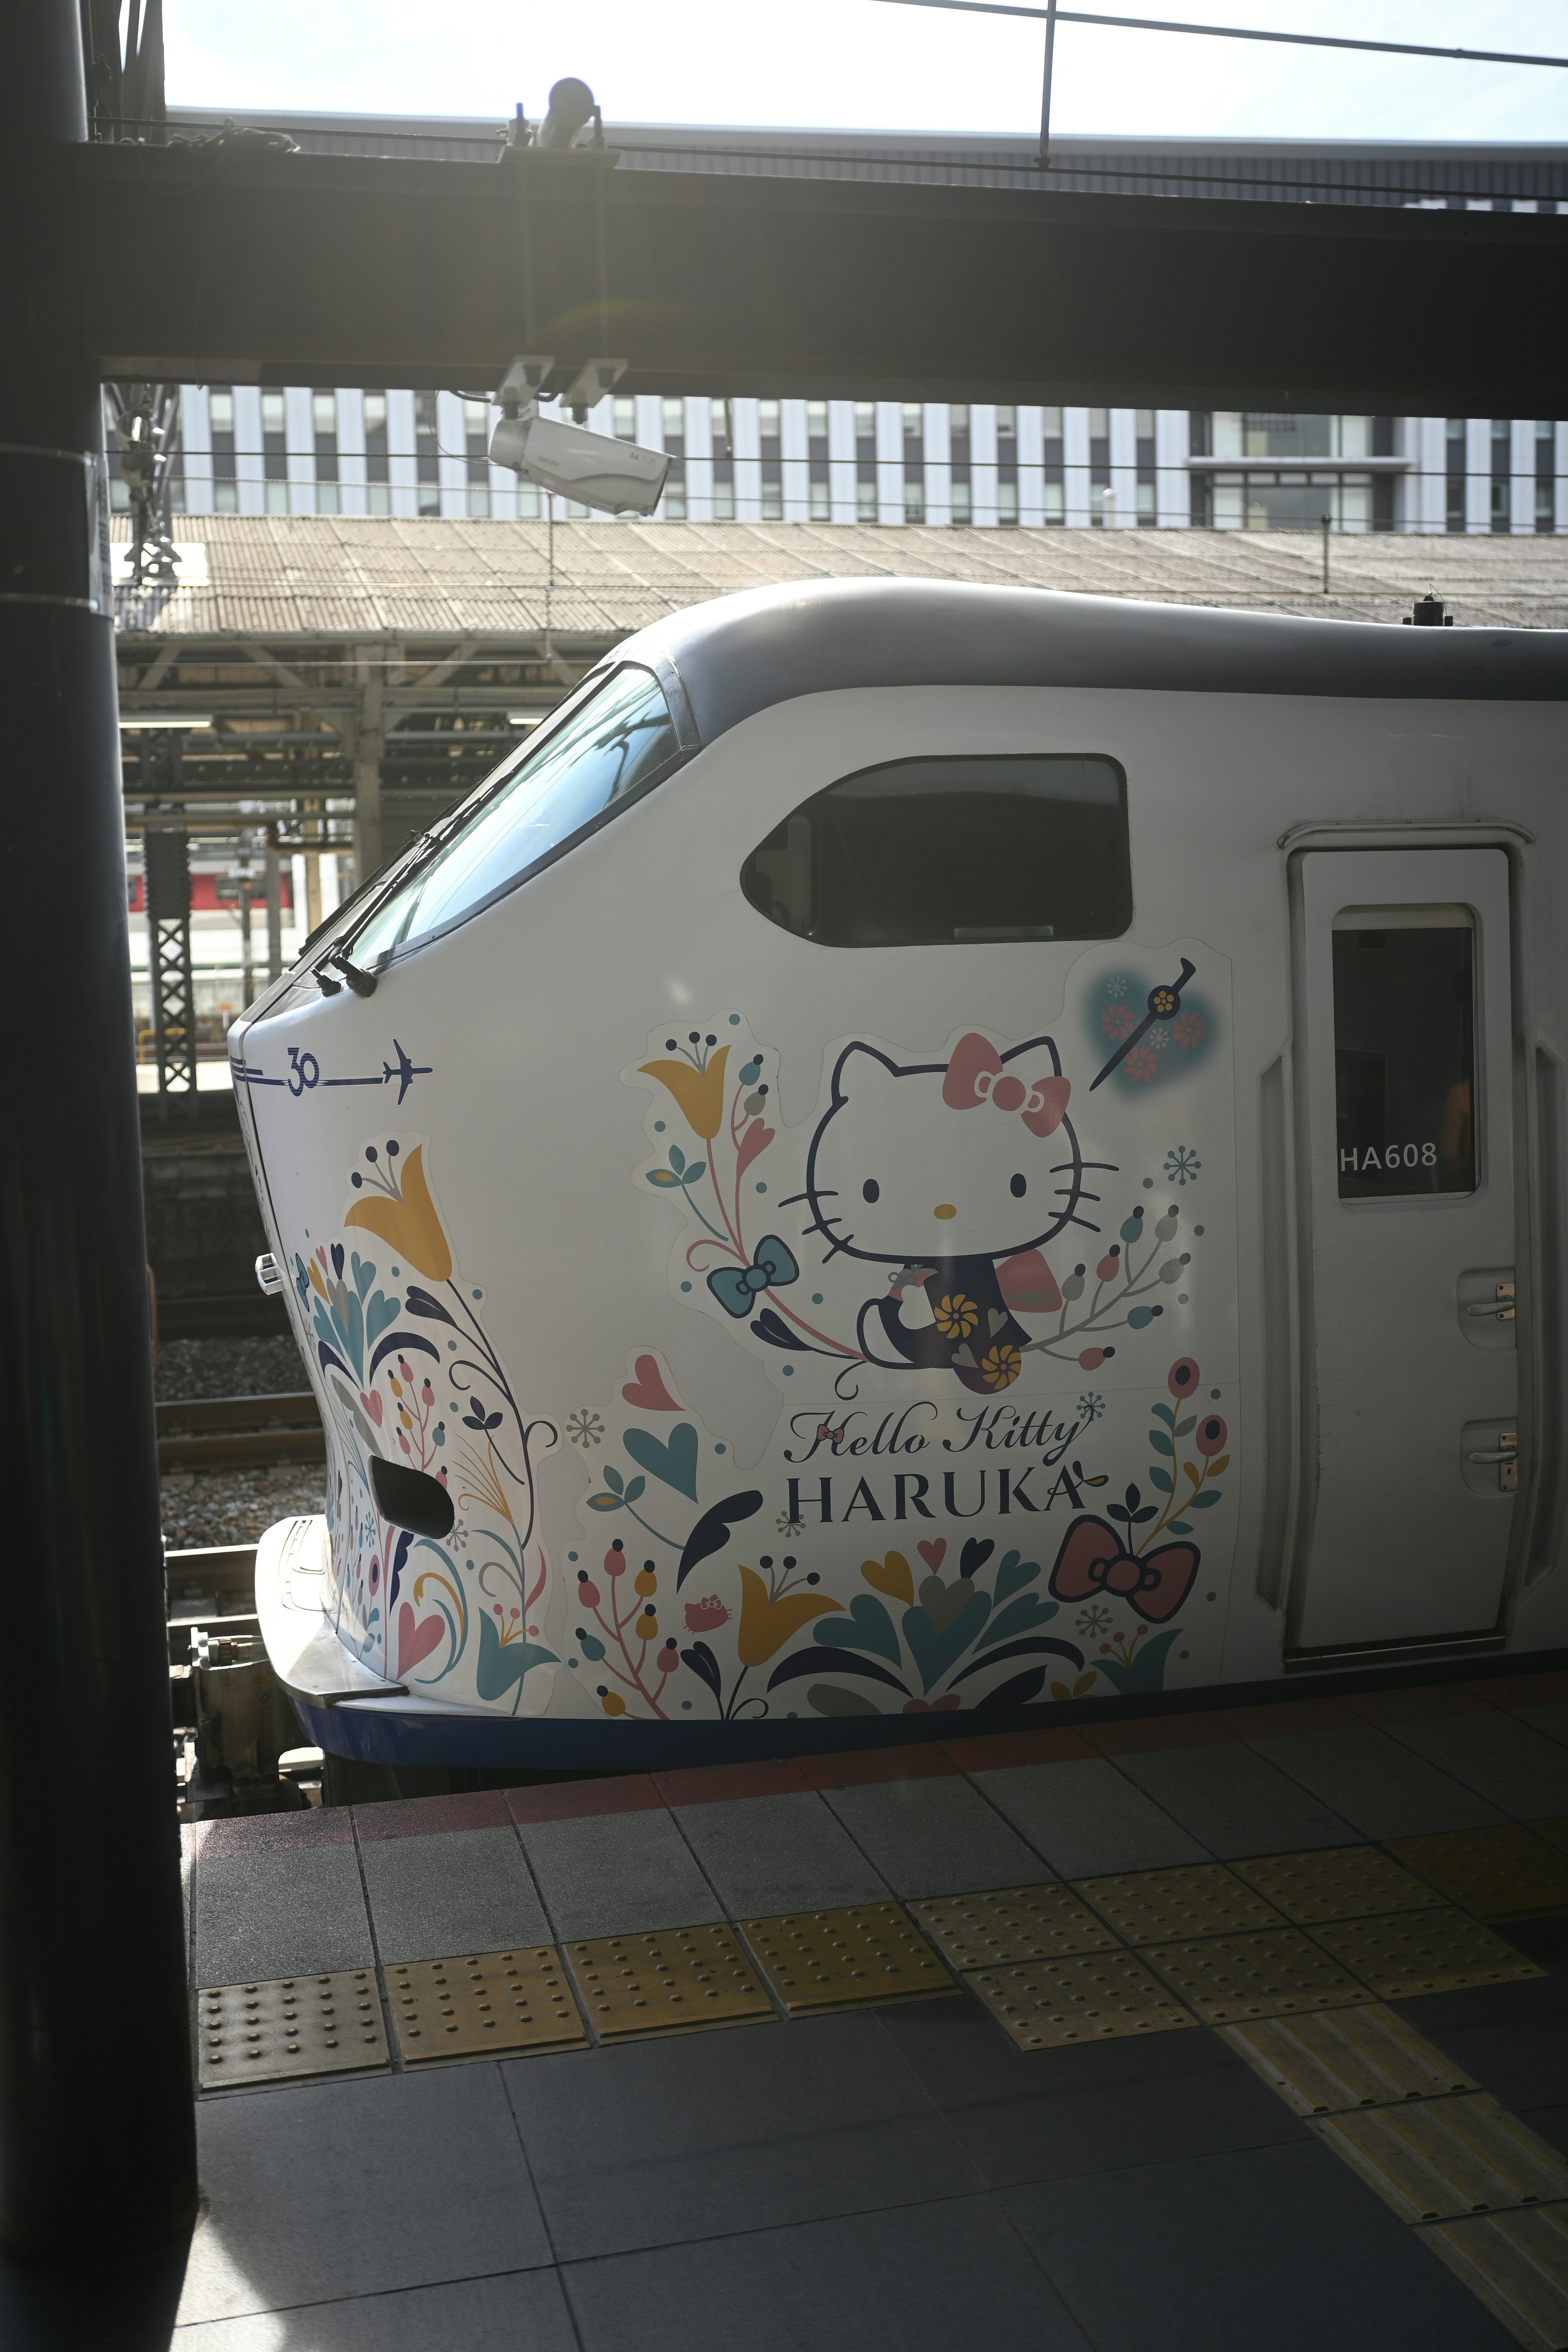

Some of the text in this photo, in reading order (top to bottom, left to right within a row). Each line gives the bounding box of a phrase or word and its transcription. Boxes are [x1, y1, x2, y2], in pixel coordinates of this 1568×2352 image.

[287, 1047, 319, 1096] 30
[1340, 1142, 1437, 1171] HA608
[783, 1401, 1094, 1466] Hello Kitty
[786, 1464, 1087, 1523] HARUKA
